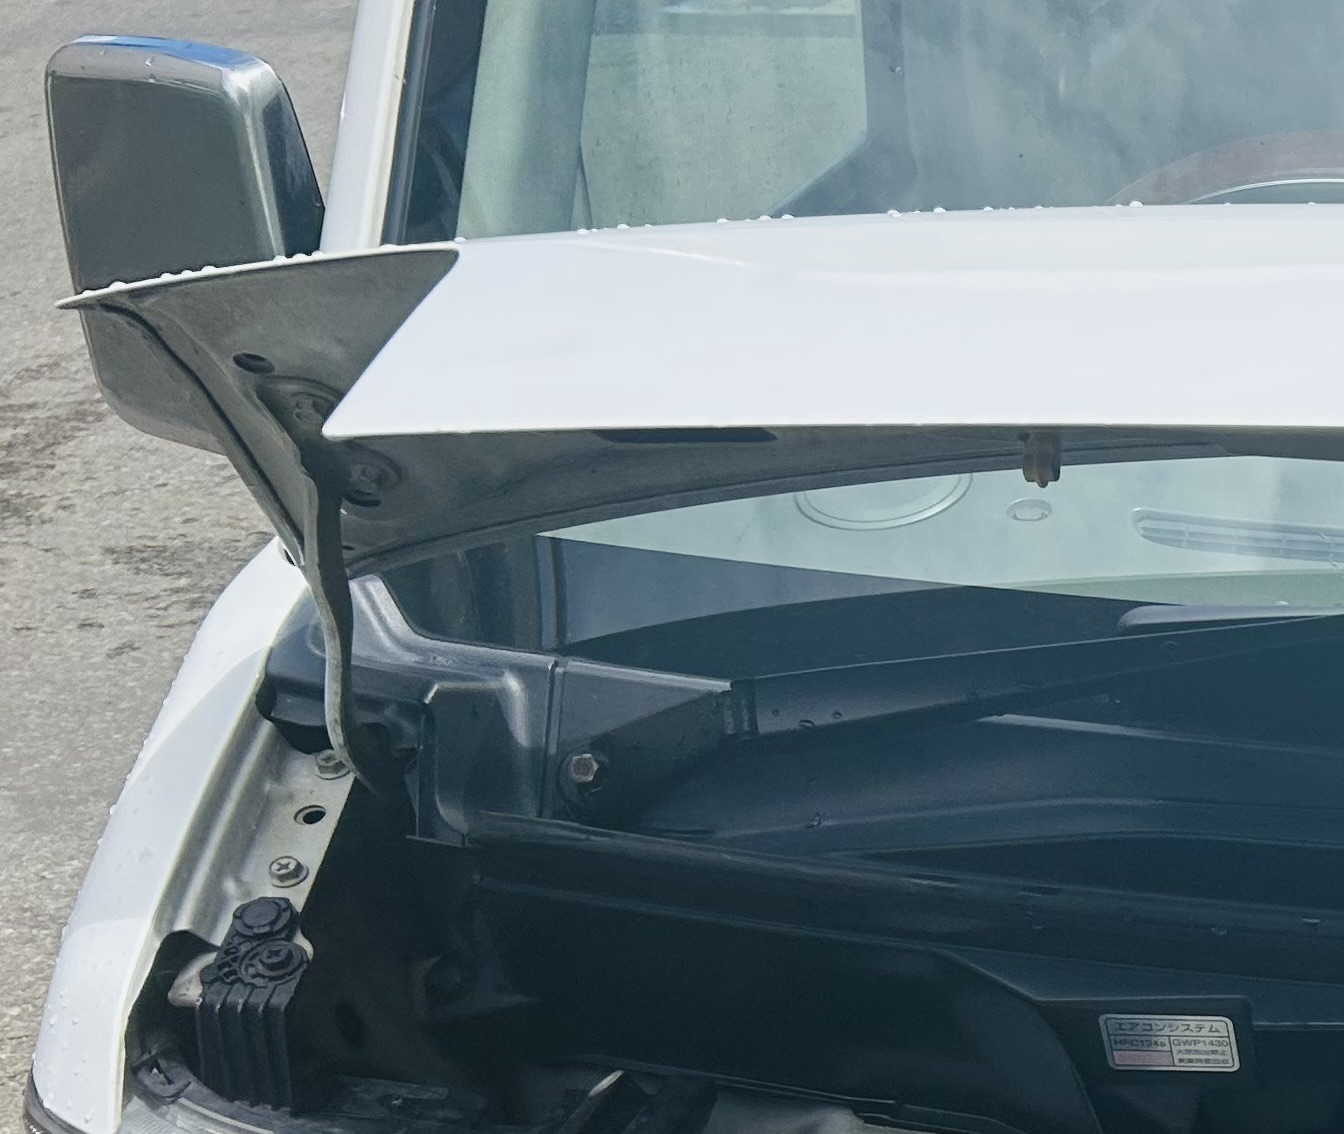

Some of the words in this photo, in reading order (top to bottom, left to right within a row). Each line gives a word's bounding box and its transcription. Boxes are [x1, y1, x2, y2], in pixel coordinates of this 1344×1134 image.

[1116, 1022, 1220, 1033] エアコンシステム
[1173, 1038, 1228, 1048] GWP1430
